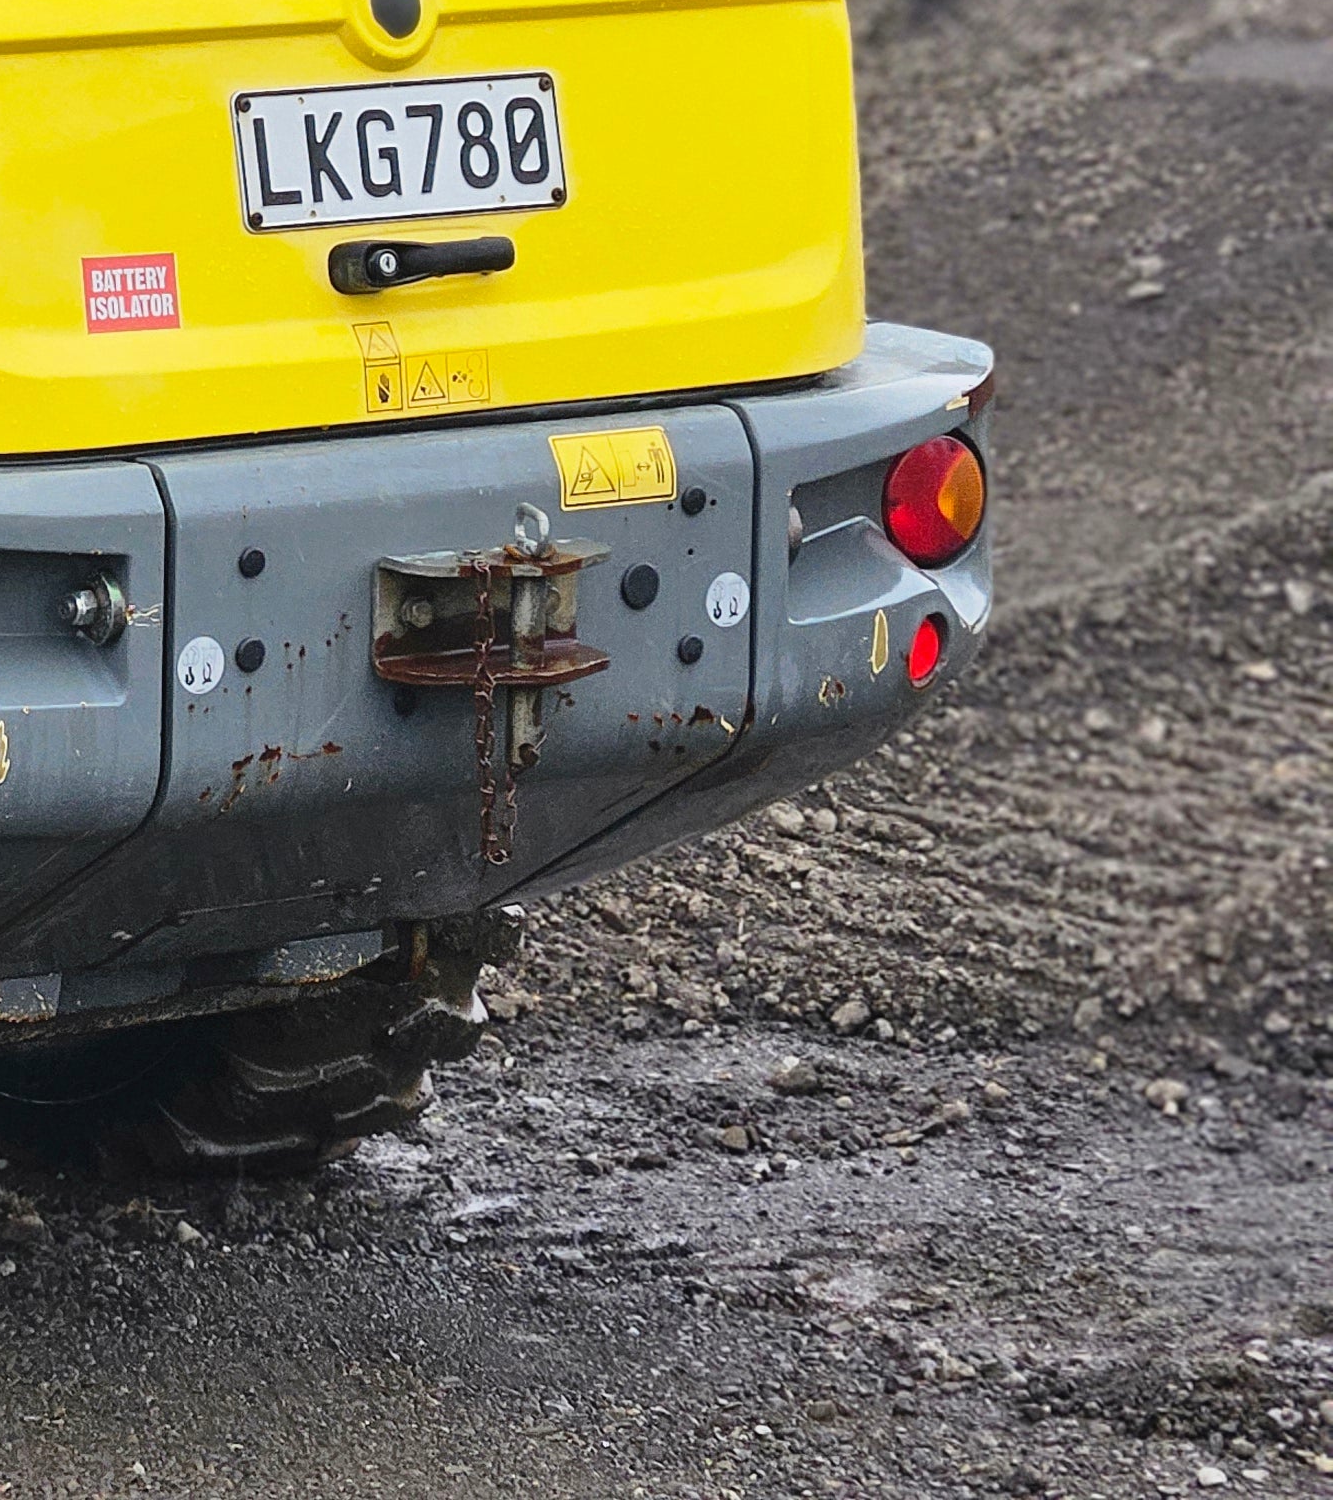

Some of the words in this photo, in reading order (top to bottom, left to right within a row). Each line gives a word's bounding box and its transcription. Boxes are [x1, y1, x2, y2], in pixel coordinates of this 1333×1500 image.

[252, 96, 550, 208] LKG780
[91, 266, 167, 293] BATTERY
[89, 293, 175, 321] ISOLATOR
